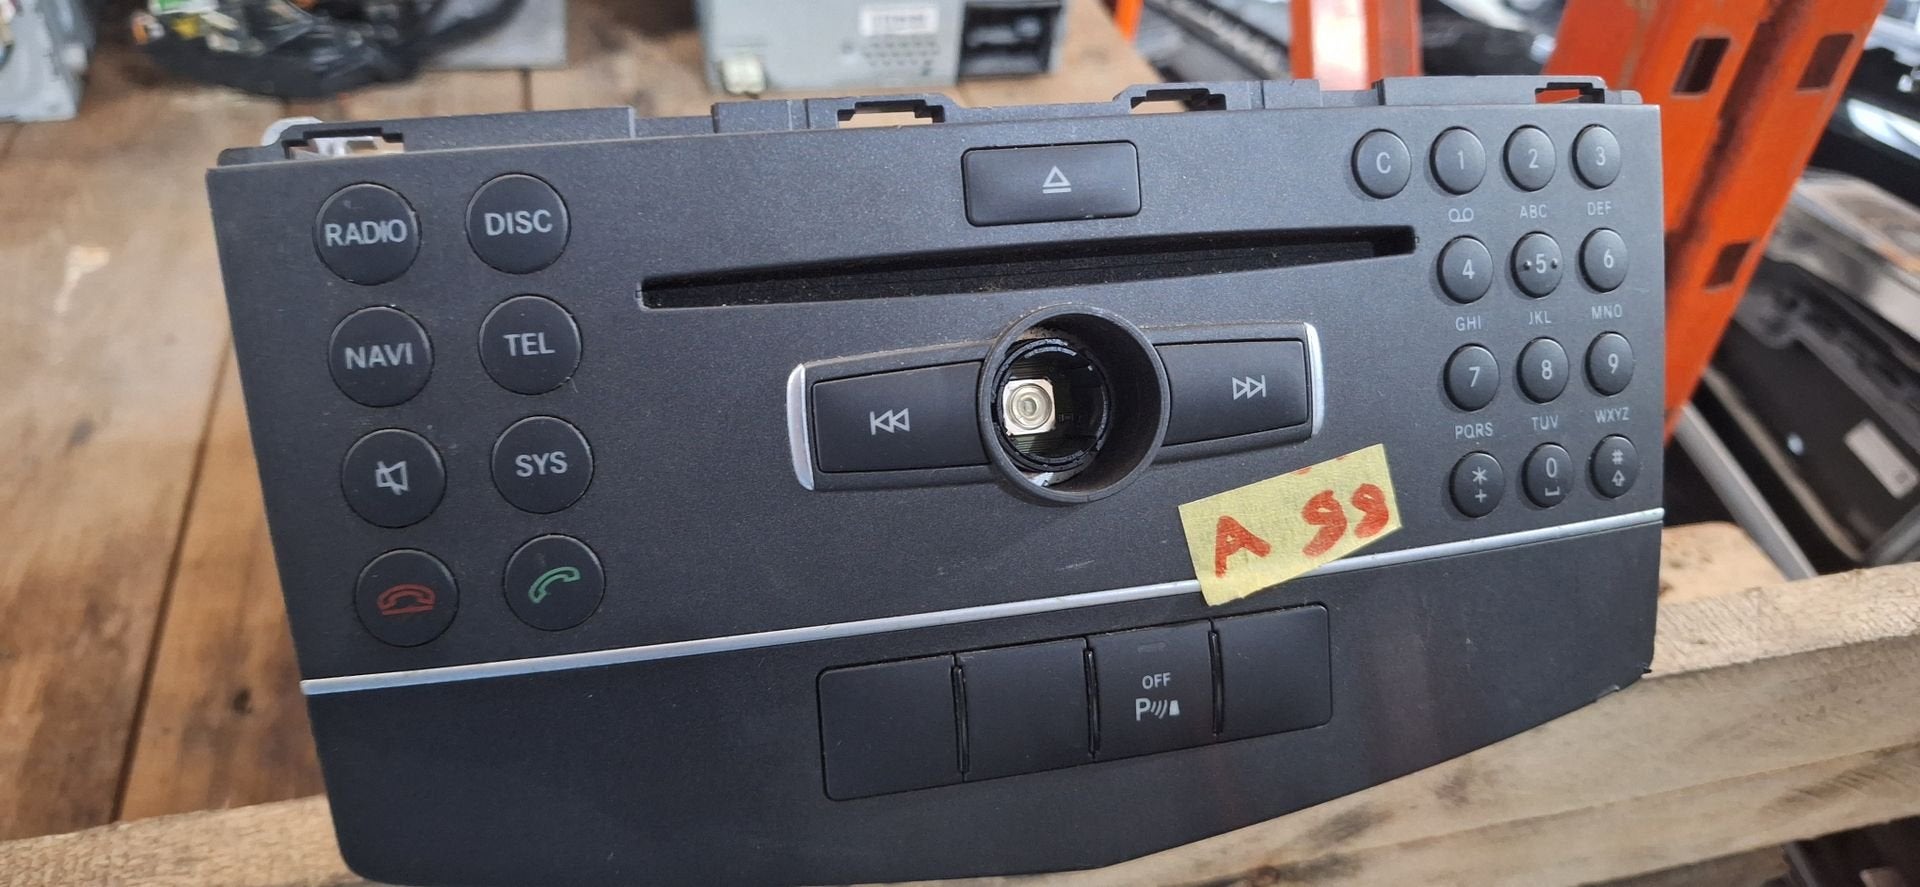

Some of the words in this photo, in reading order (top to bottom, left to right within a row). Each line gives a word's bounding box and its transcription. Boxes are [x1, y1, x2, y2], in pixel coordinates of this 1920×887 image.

[1377, 152, 1391, 173] C
[1456, 152, 1466, 170] 1
[1528, 148, 1540, 169] 2
[1595, 147, 1607, 166] 3
[1520, 204, 1546, 218] ABC
[1588, 201, 1611, 215] DEF
[485, 210, 552, 235] DISC
[325, 219, 407, 246] RADIO
[1536, 254, 1546, 273] 5
[1604, 249, 1614, 268] 6
[1463, 259, 1475, 279] 4
[1529, 311, 1551, 324] JKL
[1592, 304, 1622, 318] MNO
[1456, 316, 1481, 331] GHI
[504, 333, 555, 356] TEL
[345, 343, 412, 369] NAVI
[1608, 353, 1618, 373] 9
[1469, 366, 1480, 386] 7
[1542, 360, 1552, 379] 8
[1532, 415, 1558, 430] TUV
[1595, 407, 1629, 423] WXYZ
[1455, 422, 1493, 439] PQRS
[516, 451, 567, 477] SYS
[1546, 457, 1557, 477] 0
[1215, 515, 1271, 578] A
[1142, 672, 1171, 689] OFF
